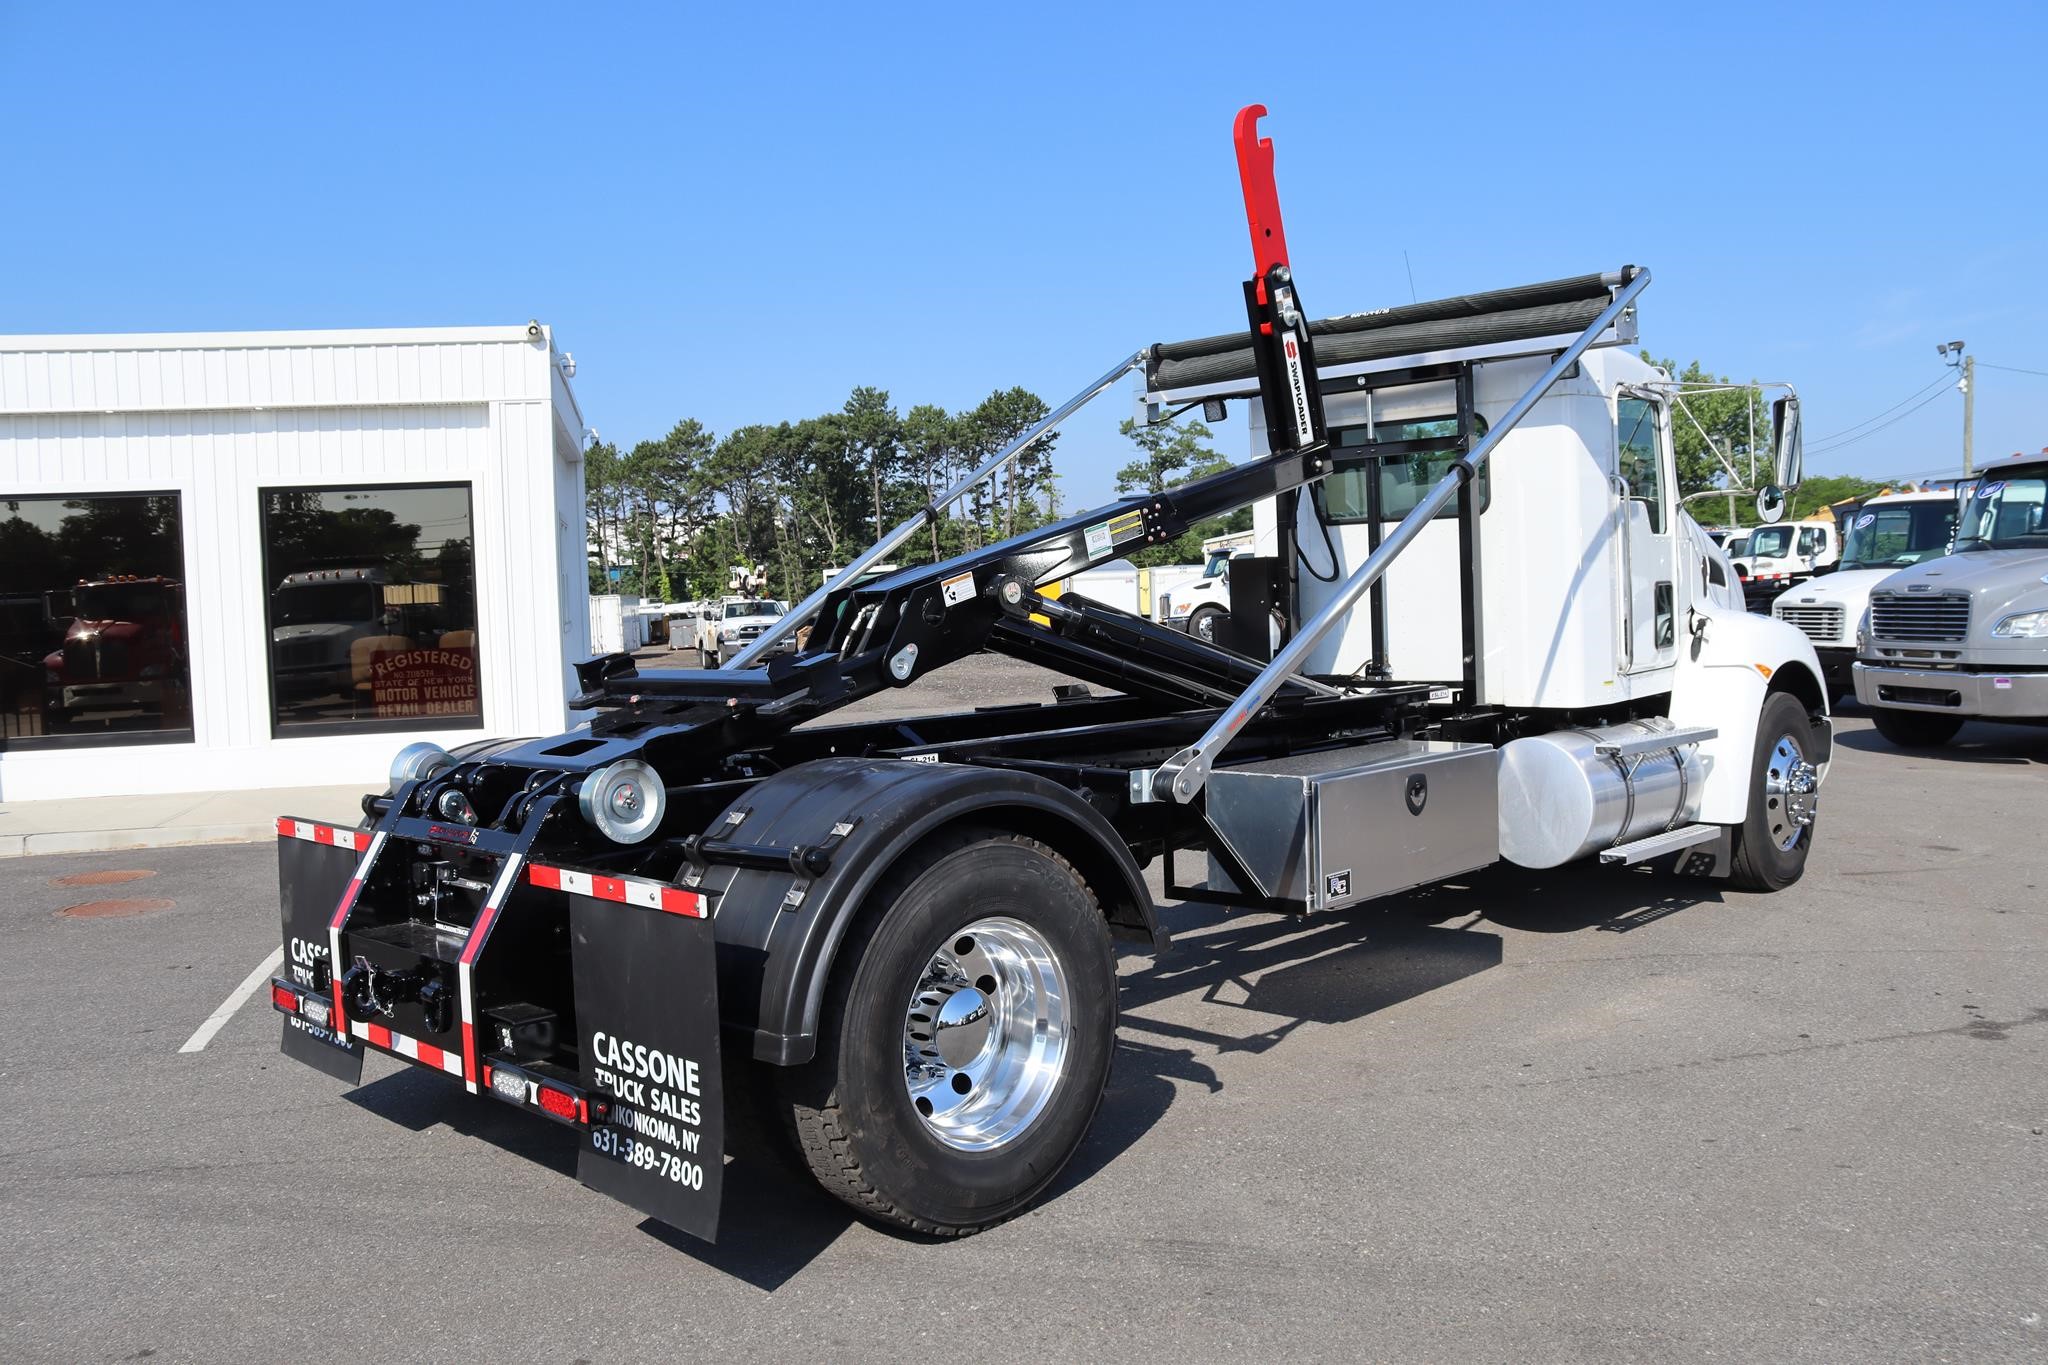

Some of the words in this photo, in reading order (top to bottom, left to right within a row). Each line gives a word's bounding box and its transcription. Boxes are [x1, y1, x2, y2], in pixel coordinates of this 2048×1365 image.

[1289, 361, 1308, 435] SWAPLOADER
[375, 651, 472, 674] REGISTERED
[374, 679, 404, 688] STATE
[407, 679, 419, 687] OF
[423, 677, 444, 685] NEW
[448, 675, 473, 684] YORK
[375, 687, 418, 702] MOTOR
[423, 684, 474, 699] VEHICLE
[378, 703, 419, 717] RETAIL
[426, 700, 473, 714] DEALER
[593, 1031, 700, 1097] CASSONE
[650, 1088, 701, 1126] SALES
[682, 1129, 700, 1154] NY
[592, 1128, 703, 1191] 631-389-7800
